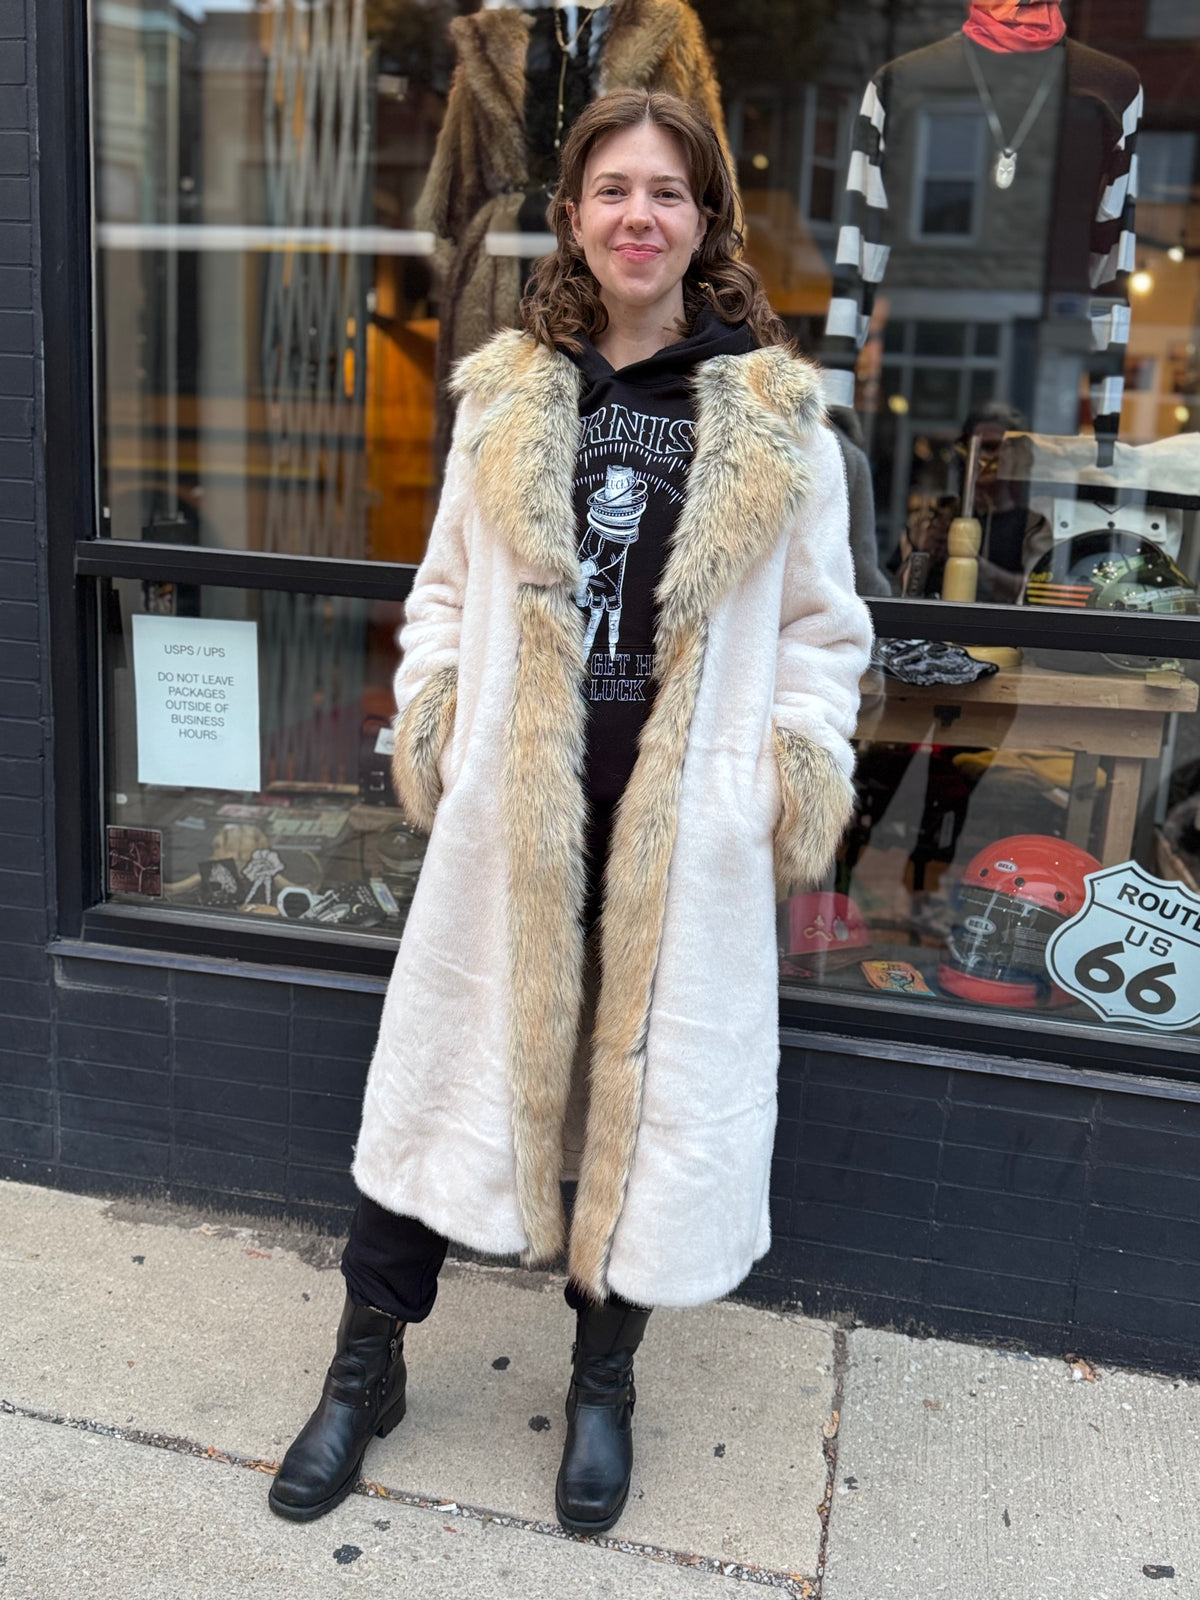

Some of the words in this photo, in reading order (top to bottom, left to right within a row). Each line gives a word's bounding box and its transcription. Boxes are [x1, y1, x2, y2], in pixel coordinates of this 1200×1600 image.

[164, 644, 195, 656] USPS
[203, 646, 226, 658] UPS
[590, 653, 630, 676] GET
[157, 671, 174, 683] DO
[177, 673, 199, 684] NOT
[202, 674, 234, 686] LEAVE
[168, 686, 226, 700] PACKAGES
[590, 679, 646, 701] LUCK
[165, 700, 212, 713] OUTSIDE
[214, 702, 229, 713] OF
[171, 714, 225, 727] BUSINESS
[178, 728, 218, 741] HOURS
[1124, 925, 1173, 958] US
[1074, 940, 1177, 1016] 66
